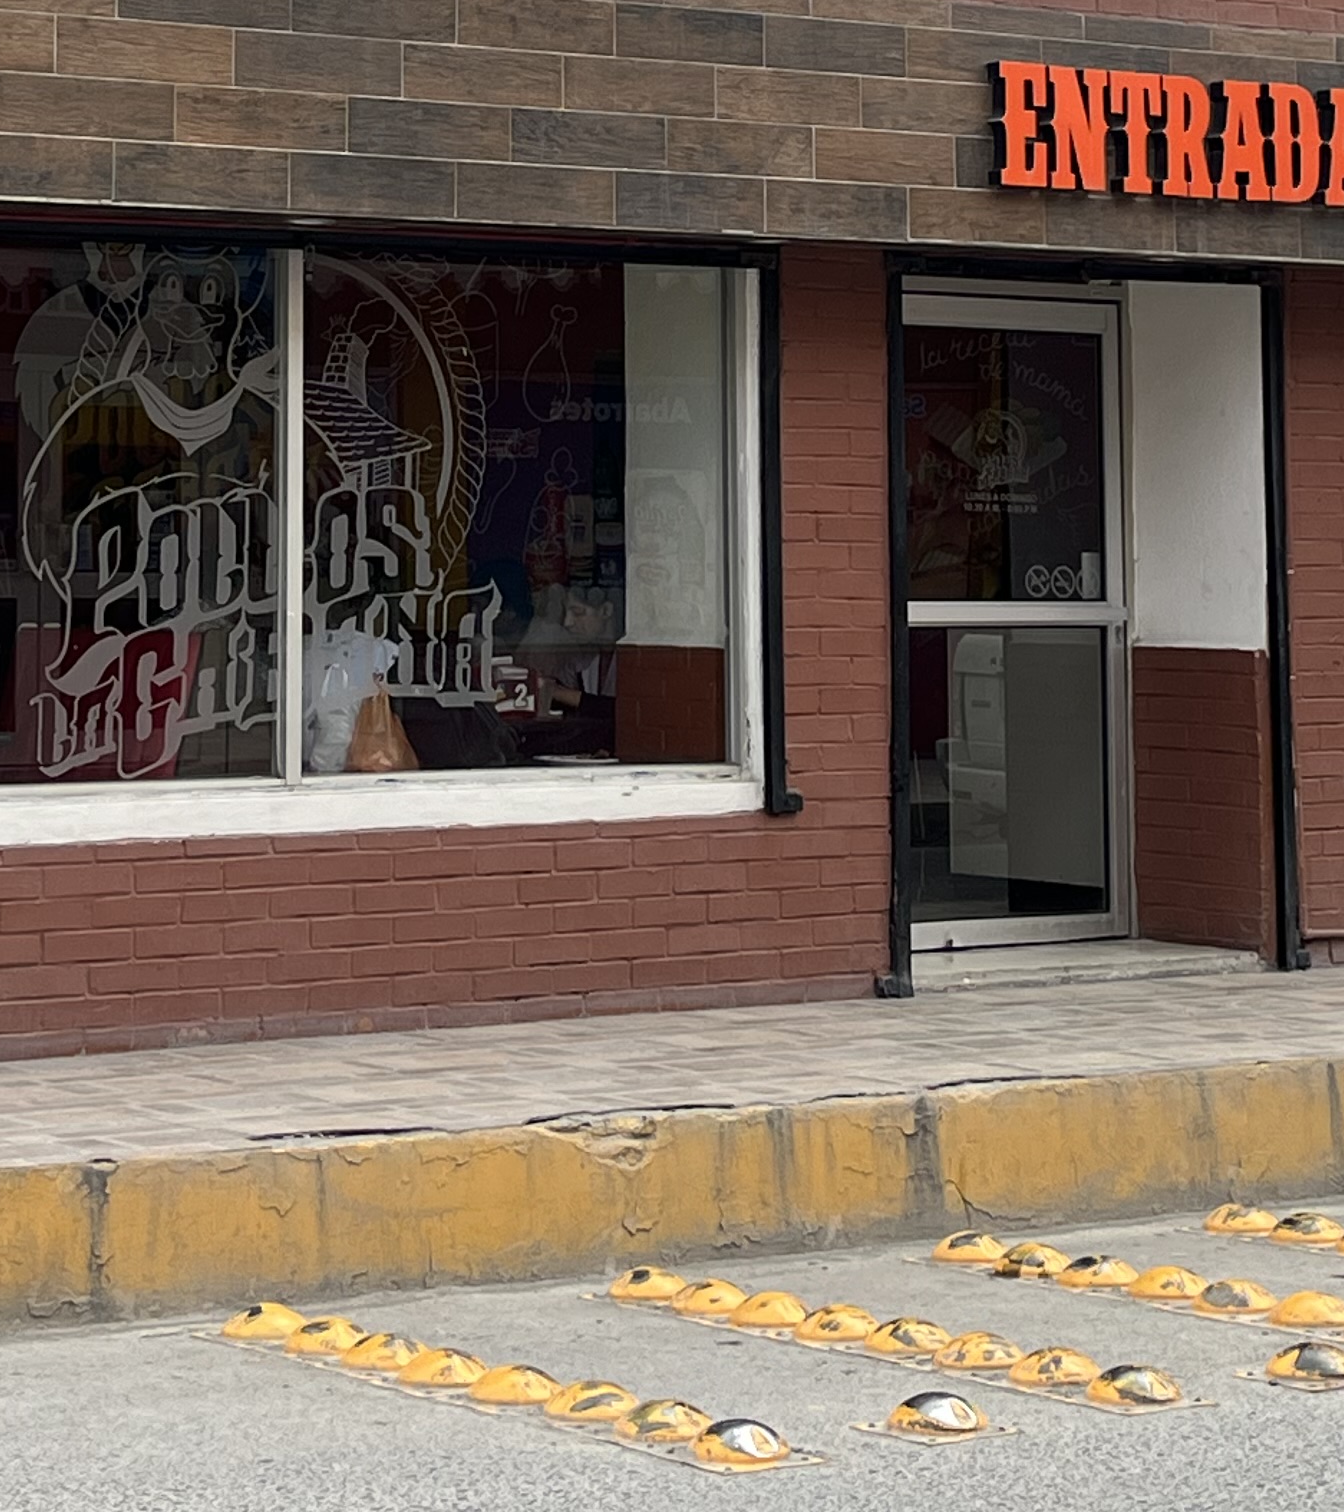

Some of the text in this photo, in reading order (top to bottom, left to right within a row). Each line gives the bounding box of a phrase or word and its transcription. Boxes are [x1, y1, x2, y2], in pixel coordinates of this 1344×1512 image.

[44, 484, 436, 696] POLLOS
[114, 566, 504, 780] CABÑA
[514, 682, 528, 707] 2
